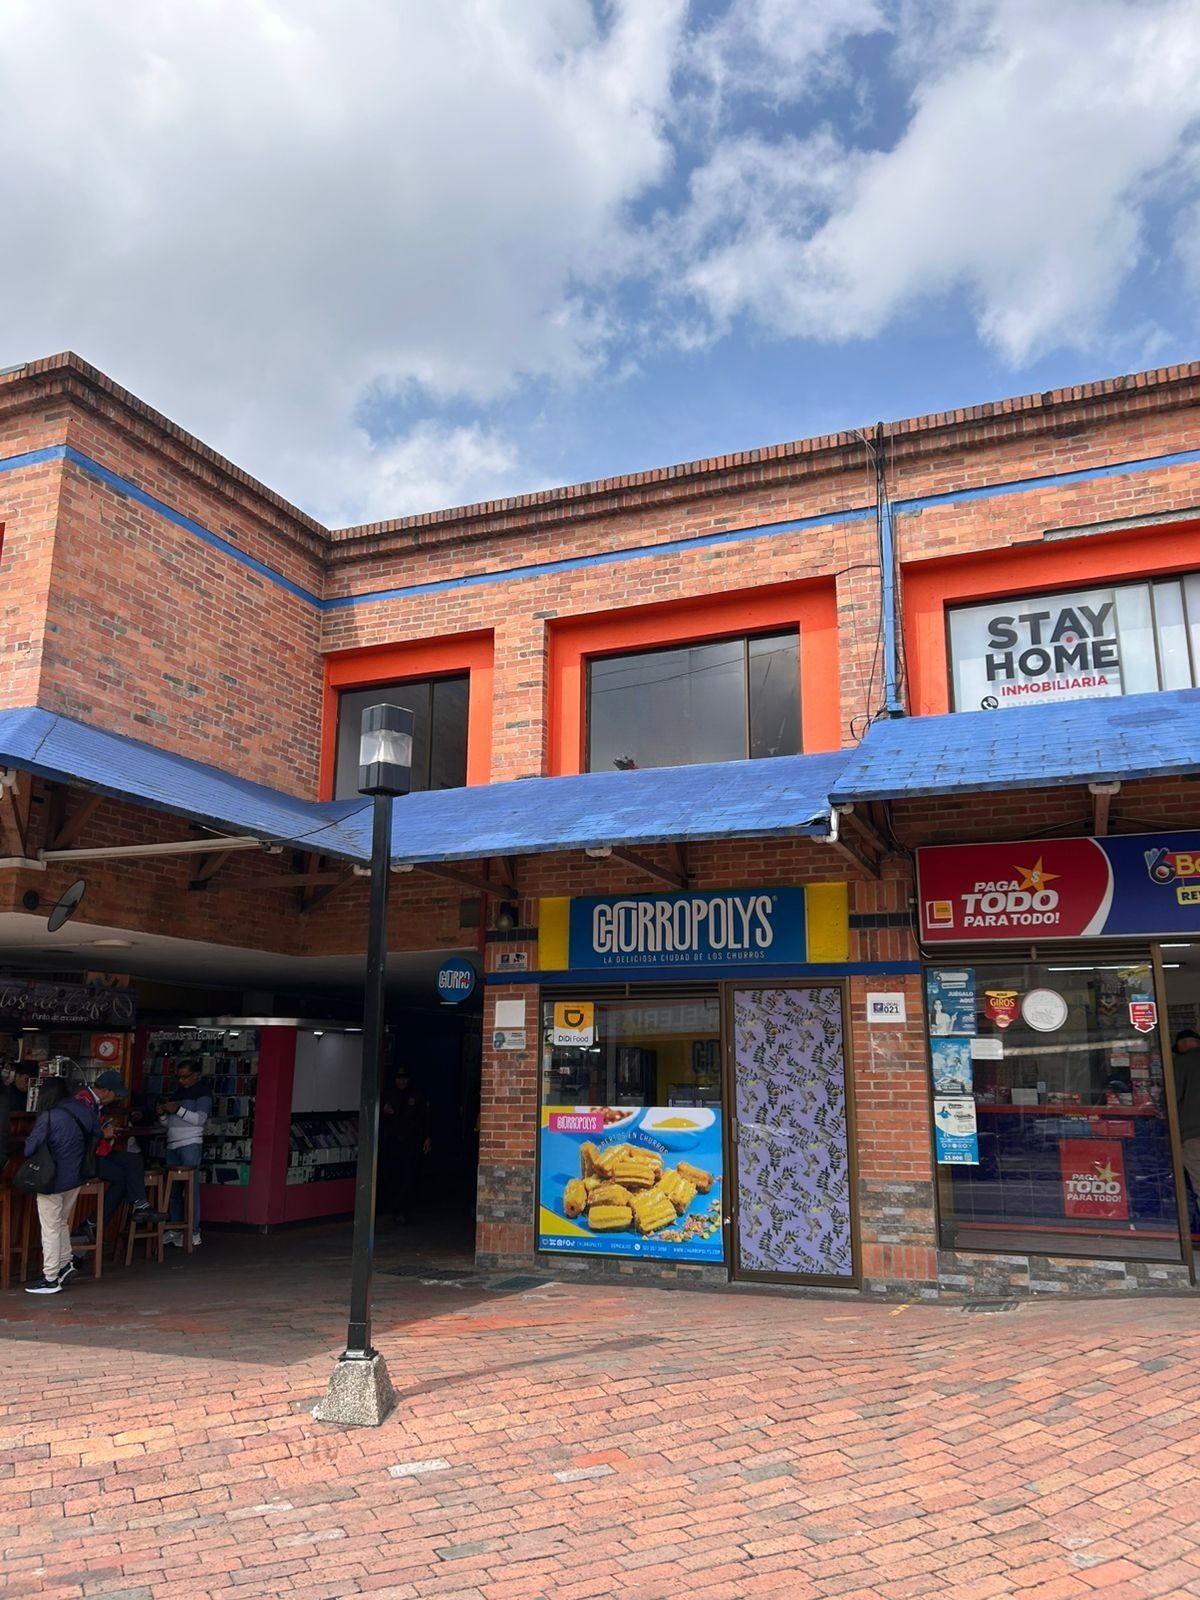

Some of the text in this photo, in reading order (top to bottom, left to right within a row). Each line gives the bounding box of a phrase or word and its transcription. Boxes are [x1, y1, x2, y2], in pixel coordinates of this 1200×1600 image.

[987, 602, 1115, 650] STAY
[985, 638, 1119, 682] HOME
[1001, 675, 1109, 697] INMOBILIARIA
[974, 880, 1021, 893] PAGA
[961, 889, 1060, 914] TODO
[963, 912, 1060, 928] PARA TODO!
[603, 951, 765, 964] LA DELICIOSA CIUDAD DE LOS CHURROS
[989, 997, 1016, 1007] GIROS
[884, 1006, 899, 1014] 021
[572, 1034, 589, 1042] Food
[640, 1133, 669, 1154] CHURROS
[1071, 1173, 1099, 1181] PAGA
[1065, 1180, 1121, 1194] TODO
[1066, 1194, 1122, 1203] PARA TODO!
